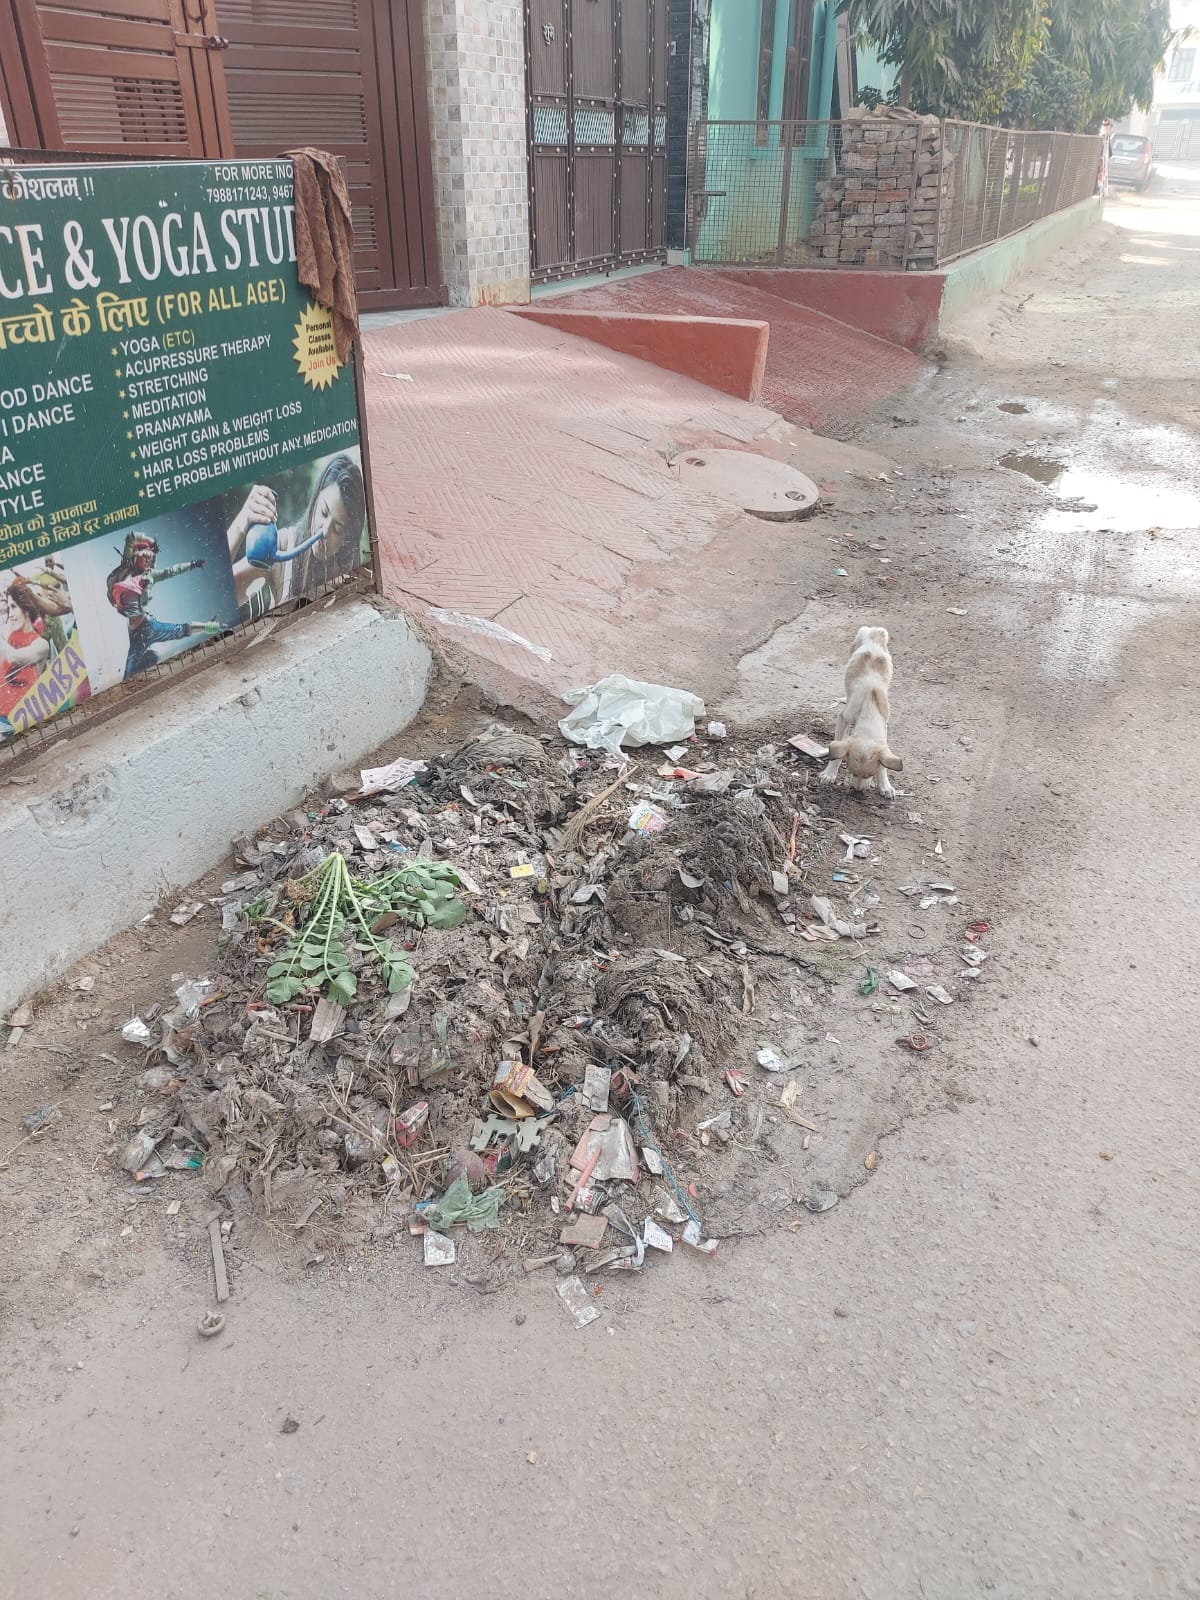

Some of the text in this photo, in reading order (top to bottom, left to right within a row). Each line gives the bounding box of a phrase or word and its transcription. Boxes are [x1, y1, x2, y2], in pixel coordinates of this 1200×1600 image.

[215, 165, 239, 182] FOR
[241, 164, 274, 181] MORE
[206, 184, 294, 204] 7988171243, 9467
[63, 219, 101, 291] &
[101, 211, 218, 284] YOGA
[60, 297, 92, 337] के
[96, 291, 151, 332] लिए
[156, 289, 204, 325] (FOR
[208, 284, 242, 313] ALL
[246, 277, 287, 305] AGE)
[120, 329, 196, 356] YOGA (ETC)
[305, 320, 332, 333] Personal
[308, 333, 331, 344] Classes
[125, 333, 272, 379] ACUPRESSURE THERAPY
[308, 355, 337, 371] Join Us
[0, 373, 95, 410] OD DANCE
[128, 367, 209, 400] STRETCHING
[12, 403, 76, 434] DANCE
[131, 388, 207, 420] MEDITATION
[135, 407, 213, 440] PRANAYAMA
[138, 400, 304, 460] WEIGHT GAIN & WEIGHT LOSS
[142, 428, 271, 480] HAIR LOSS PROBLEMS
[146, 418, 357, 499] EYE PROBLEM WITHOUT ANY MEDICATION
[27, 513, 46, 532] को
[49, 499, 98, 526] अपनाया
[37, 531, 51, 548] के
[52, 521, 82, 543] लिये
[84, 516, 101, 535] दूर
[103, 503, 141, 526] भगाया
